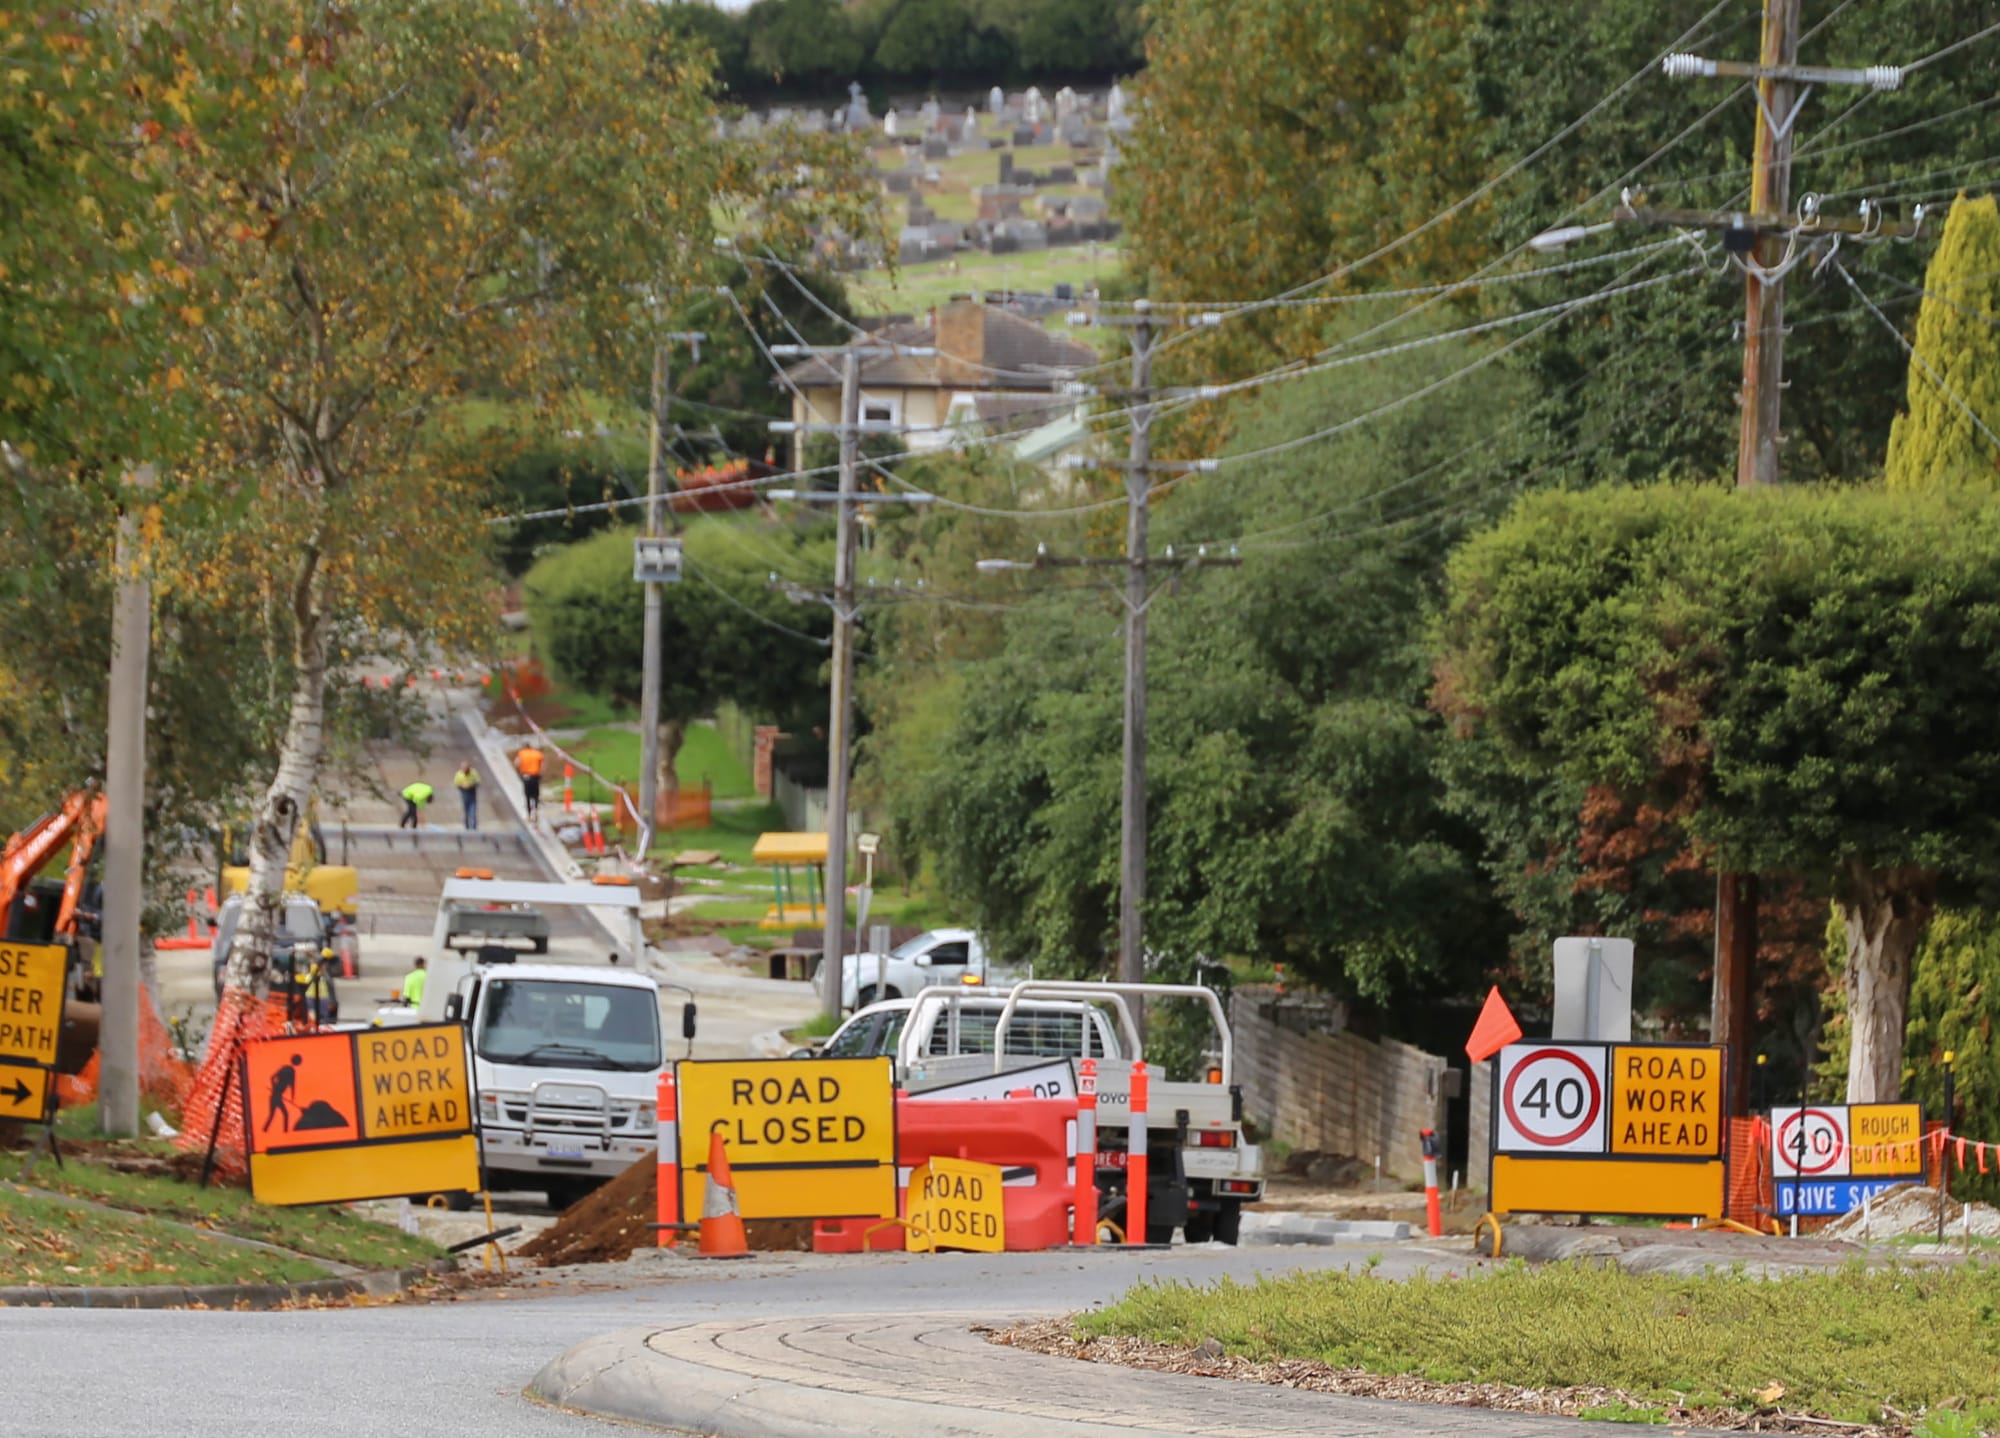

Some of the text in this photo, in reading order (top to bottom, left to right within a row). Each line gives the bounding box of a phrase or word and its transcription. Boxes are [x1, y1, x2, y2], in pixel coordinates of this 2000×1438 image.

[0, 1024, 53, 1051] PATH
[371, 1036, 449, 1063] ROAD
[373, 1068, 453, 1095] WORK
[1627, 1056, 1706, 1080] ROAD
[733, 1077, 840, 1105] ROAD
[1520, 1077, 1584, 1119] 40
[1626, 1089, 1706, 1112] WORK
[376, 1100, 457, 1128] AHEAD
[1861, 1116, 1909, 1137] ROUGH
[709, 1116, 865, 1145] CLOSED
[1624, 1122, 1708, 1146] AHEAD
[1788, 1126, 1832, 1156] 40
[924, 1173, 982, 1201] ROAD
[1783, 1186, 1836, 1210] DRIVE
[911, 1208, 997, 1238] CLOSED
